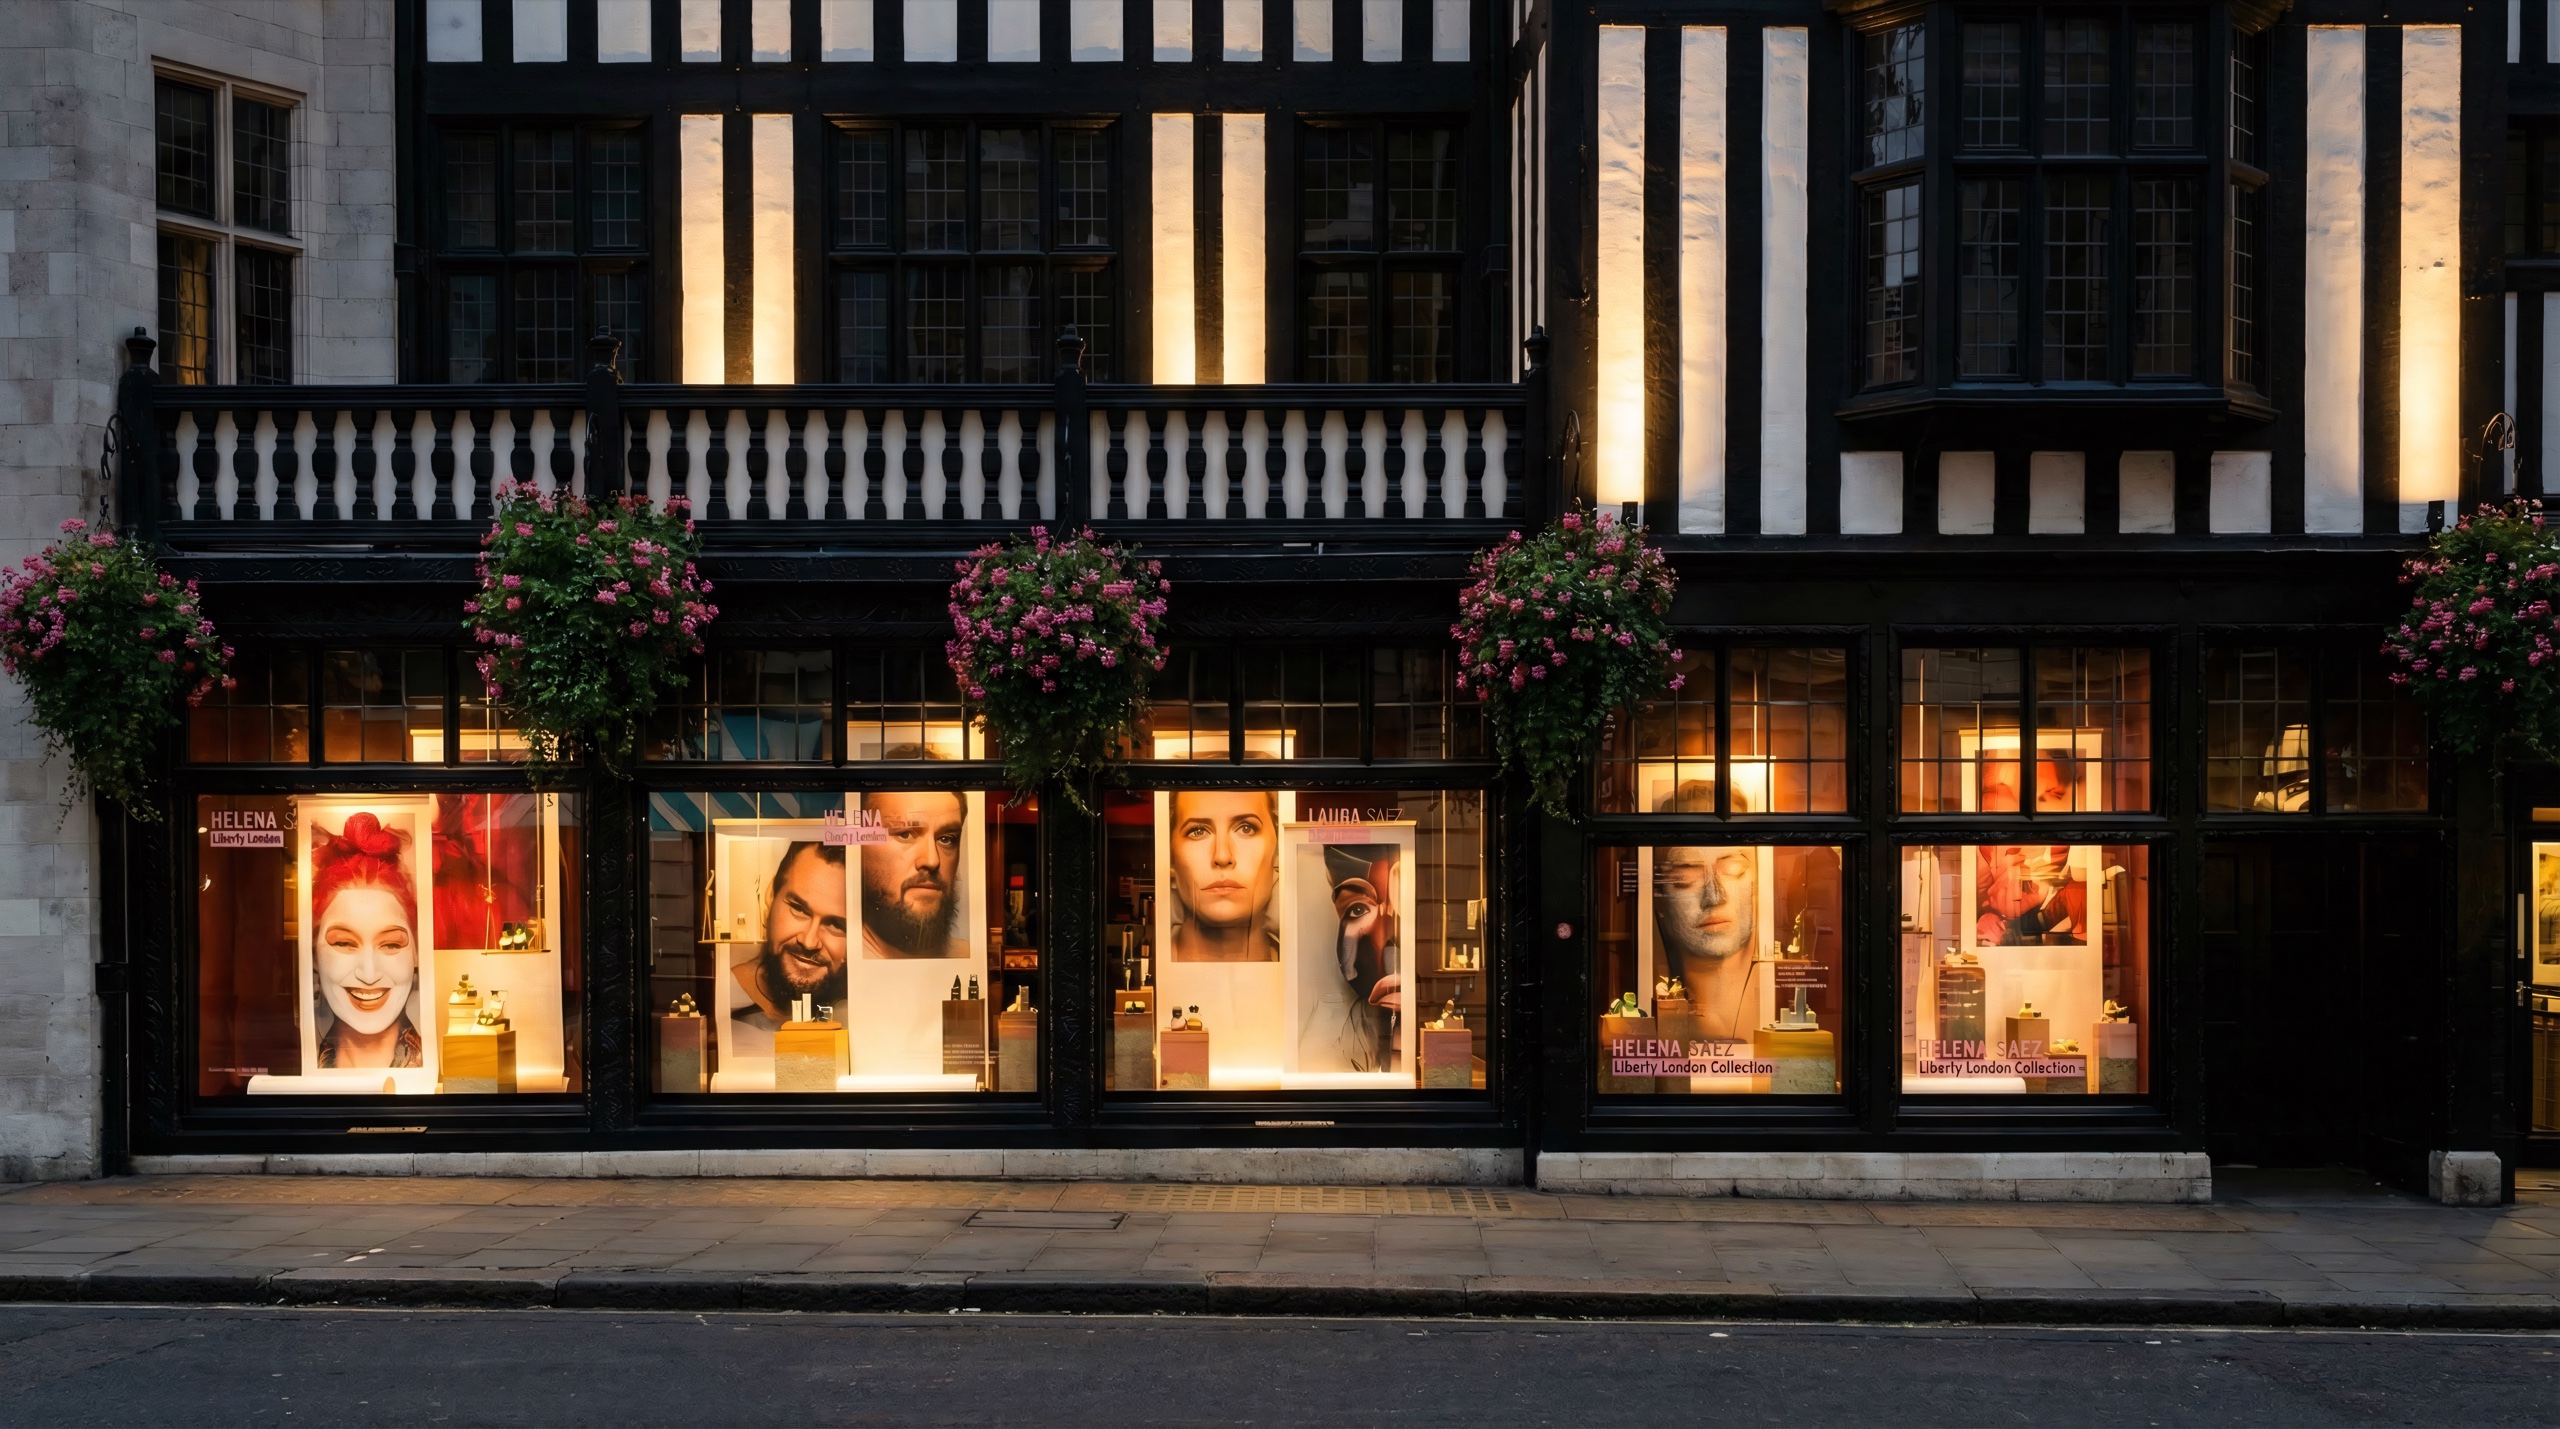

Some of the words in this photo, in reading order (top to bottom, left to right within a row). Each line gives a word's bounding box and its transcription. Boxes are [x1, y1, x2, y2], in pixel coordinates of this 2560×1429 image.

[211, 811, 277, 829] HELENA
[1612, 1039, 1682, 1057] HELENA
[1688, 1039, 1735, 1057] SAEZ
[1918, 1039, 1987, 1058] HELENA
[1996, 1039, 2043, 1058] SAEZ
[1661, 1060, 1707, 1074] London
[1710, 1060, 1773, 1074] Collection
[1919, 1060, 1963, 1077] Liberty
[1966, 1060, 2012, 1074] London
[2014, 1060, 2076, 1074] Collection
